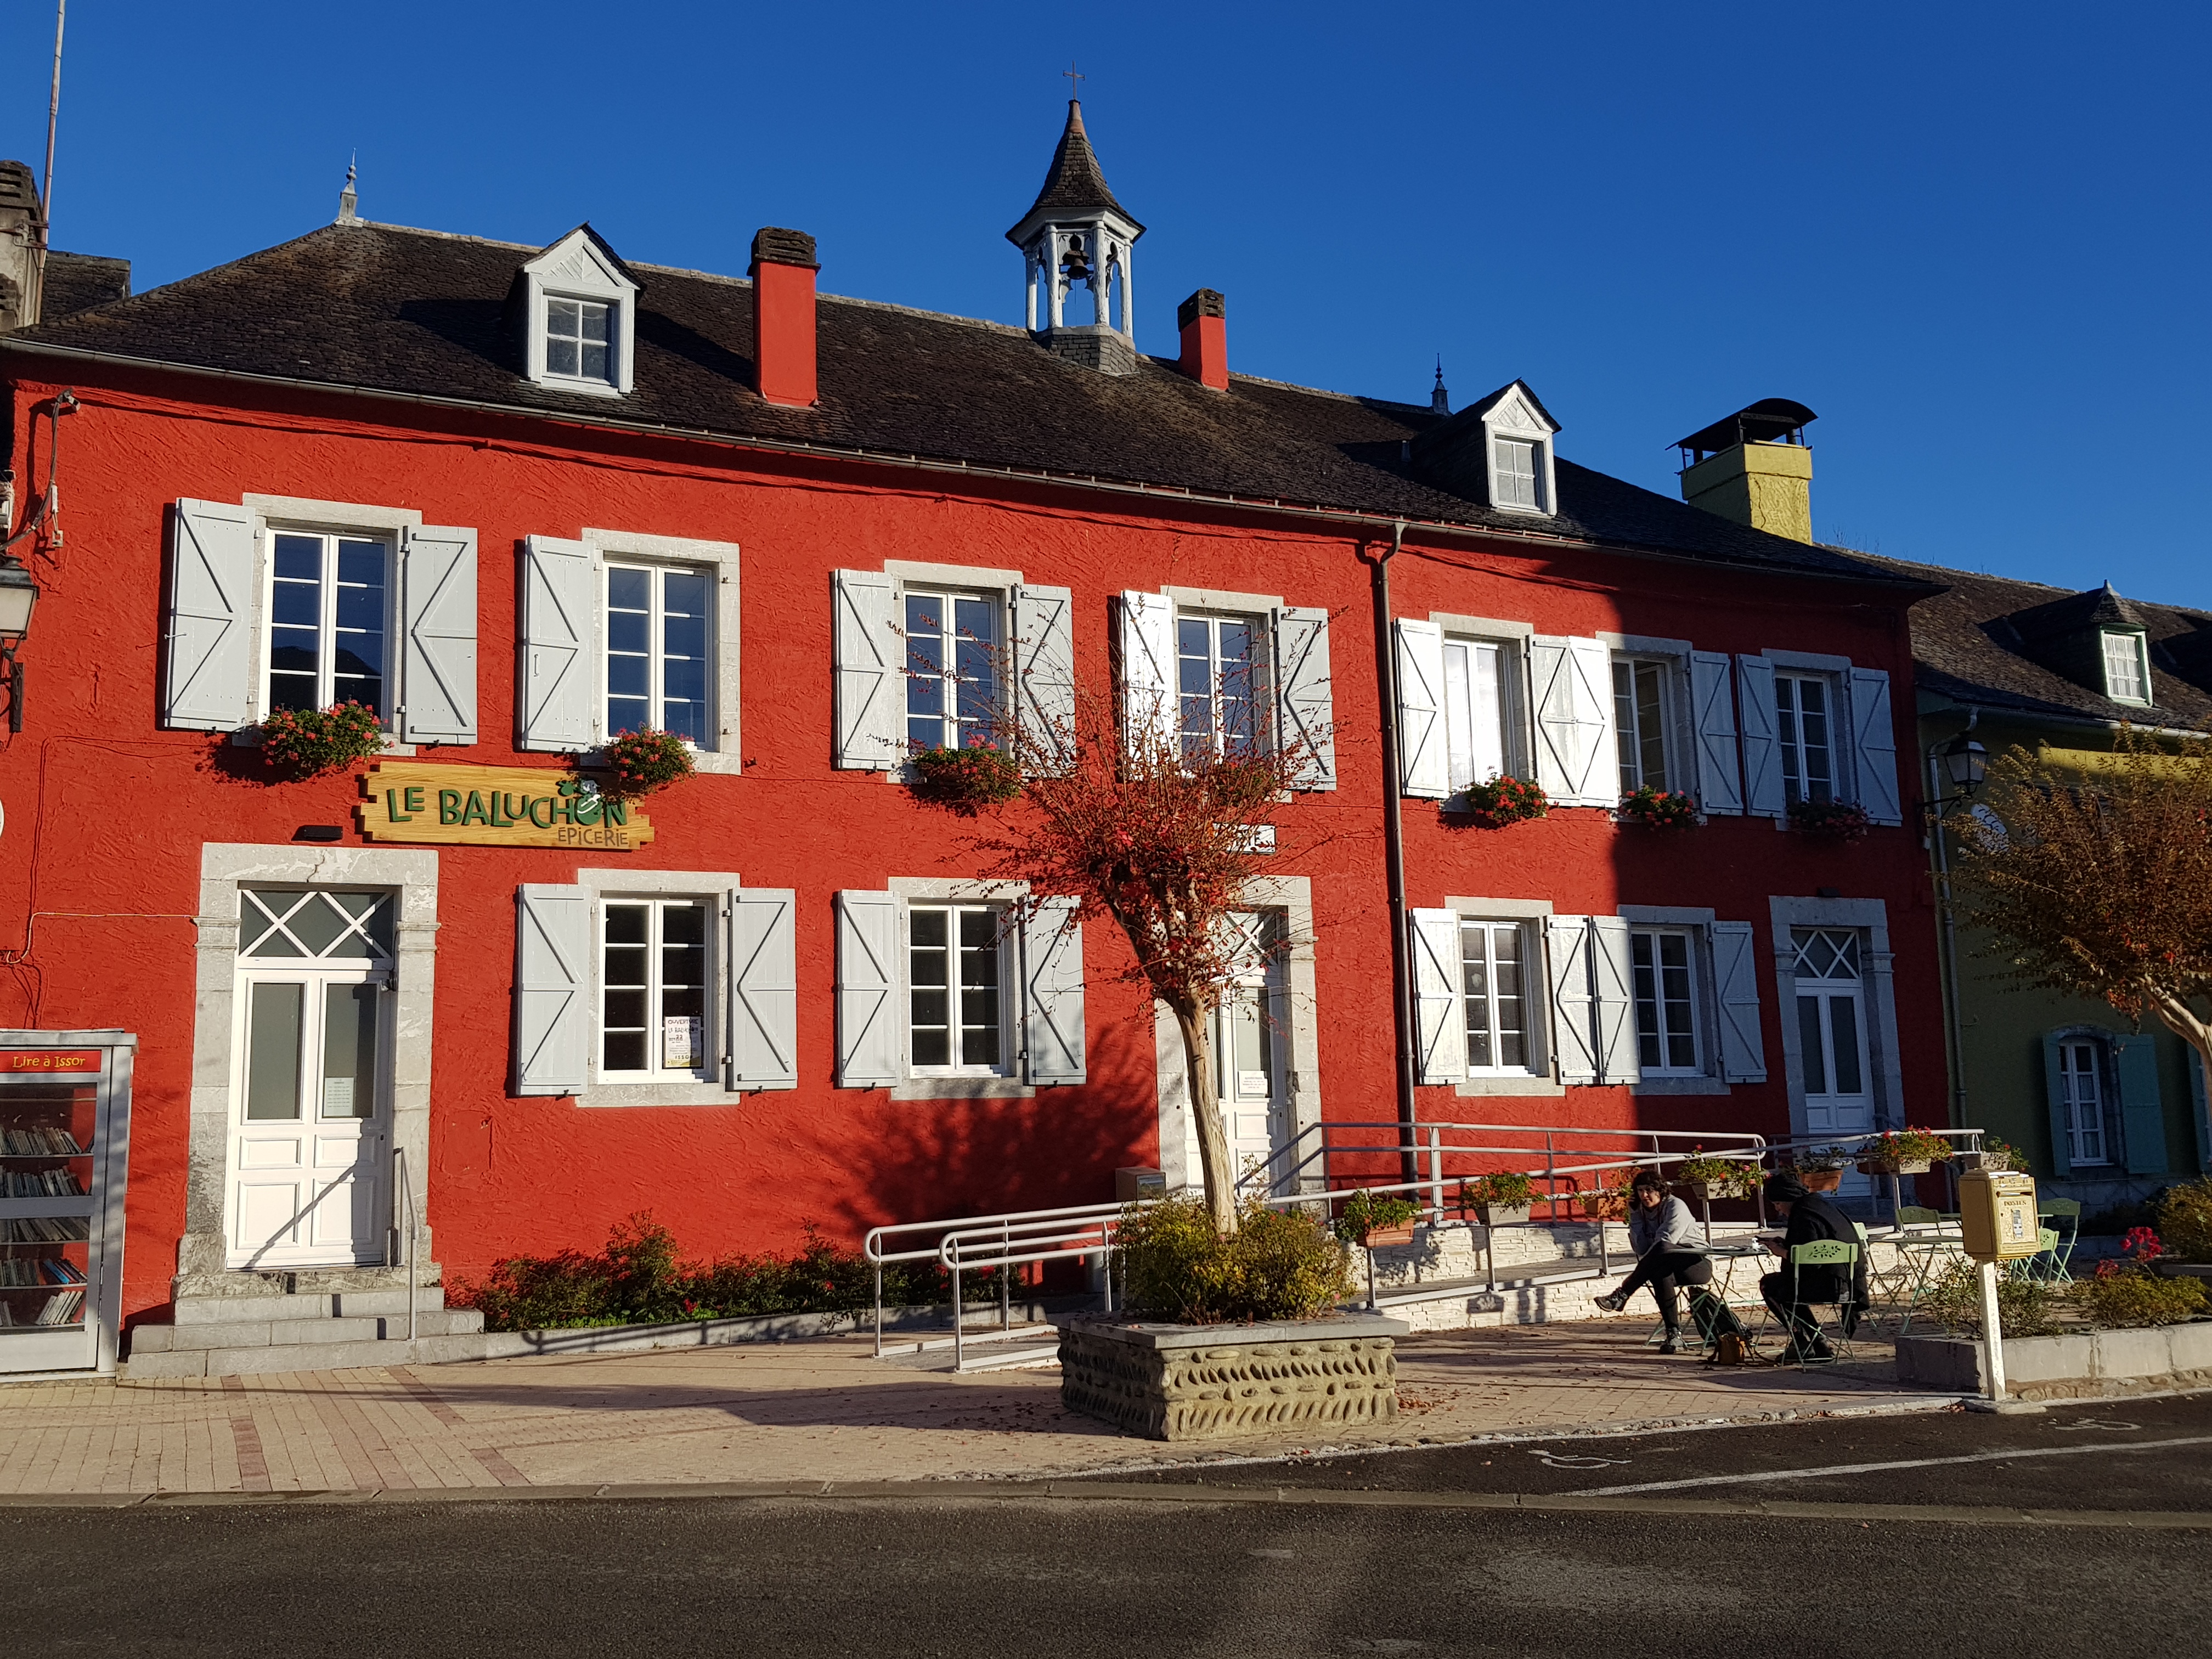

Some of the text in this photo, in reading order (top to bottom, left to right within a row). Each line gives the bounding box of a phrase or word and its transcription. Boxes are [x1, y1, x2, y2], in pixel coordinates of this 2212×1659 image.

[387, 786, 628, 828] LE BALUCHON
[12, 1054, 86, 1069] Lire à Issor
